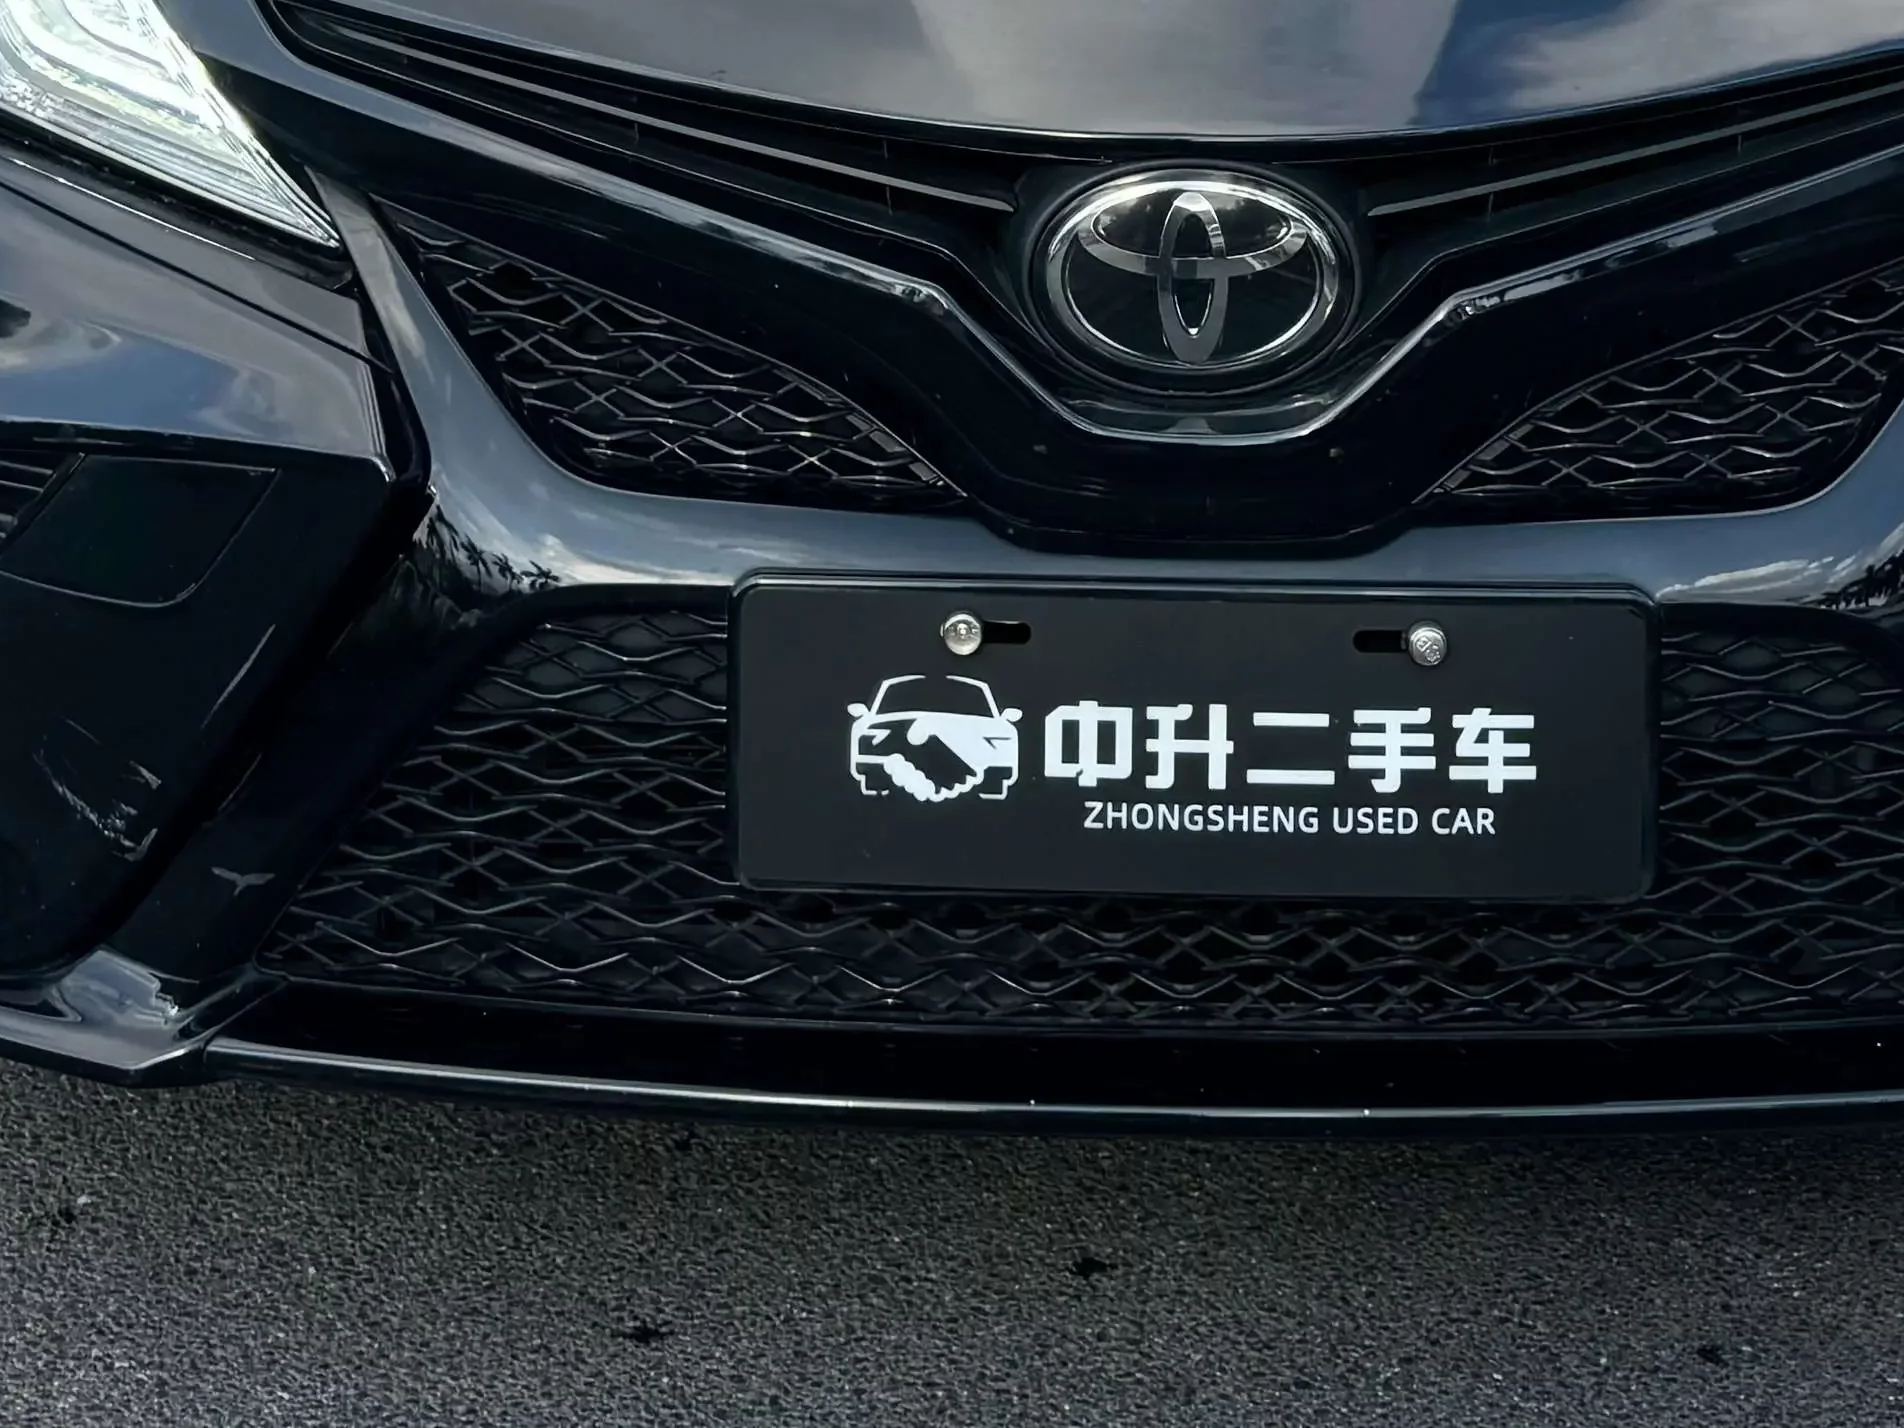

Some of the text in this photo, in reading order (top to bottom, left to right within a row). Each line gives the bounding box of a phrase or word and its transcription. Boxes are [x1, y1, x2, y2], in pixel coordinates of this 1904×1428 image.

[1044, 700, 1537, 794] 中升二手车
[1083, 801, 1497, 836] ZHONGSHENG USED CAR
